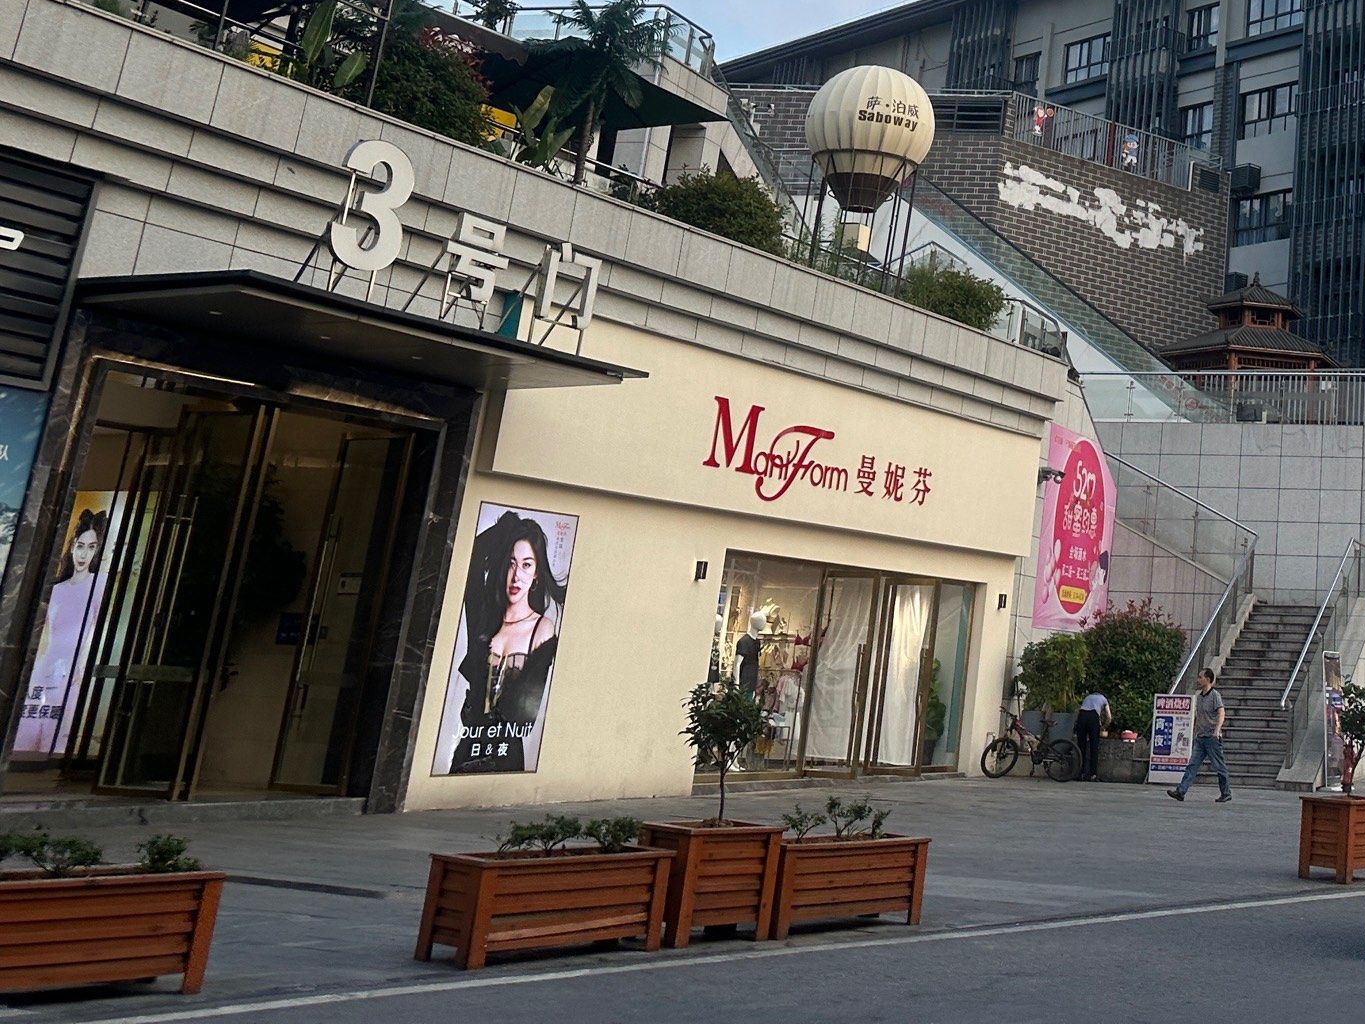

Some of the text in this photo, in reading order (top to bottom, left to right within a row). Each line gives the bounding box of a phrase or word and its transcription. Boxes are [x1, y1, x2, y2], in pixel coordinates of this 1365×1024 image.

[858, 110, 918, 132] Saboway
[854, 455, 932, 506] 曼妮芬
[453, 722, 532, 738] Jour et Nuit
[471, 742, 509, 756] 日 & 夜
